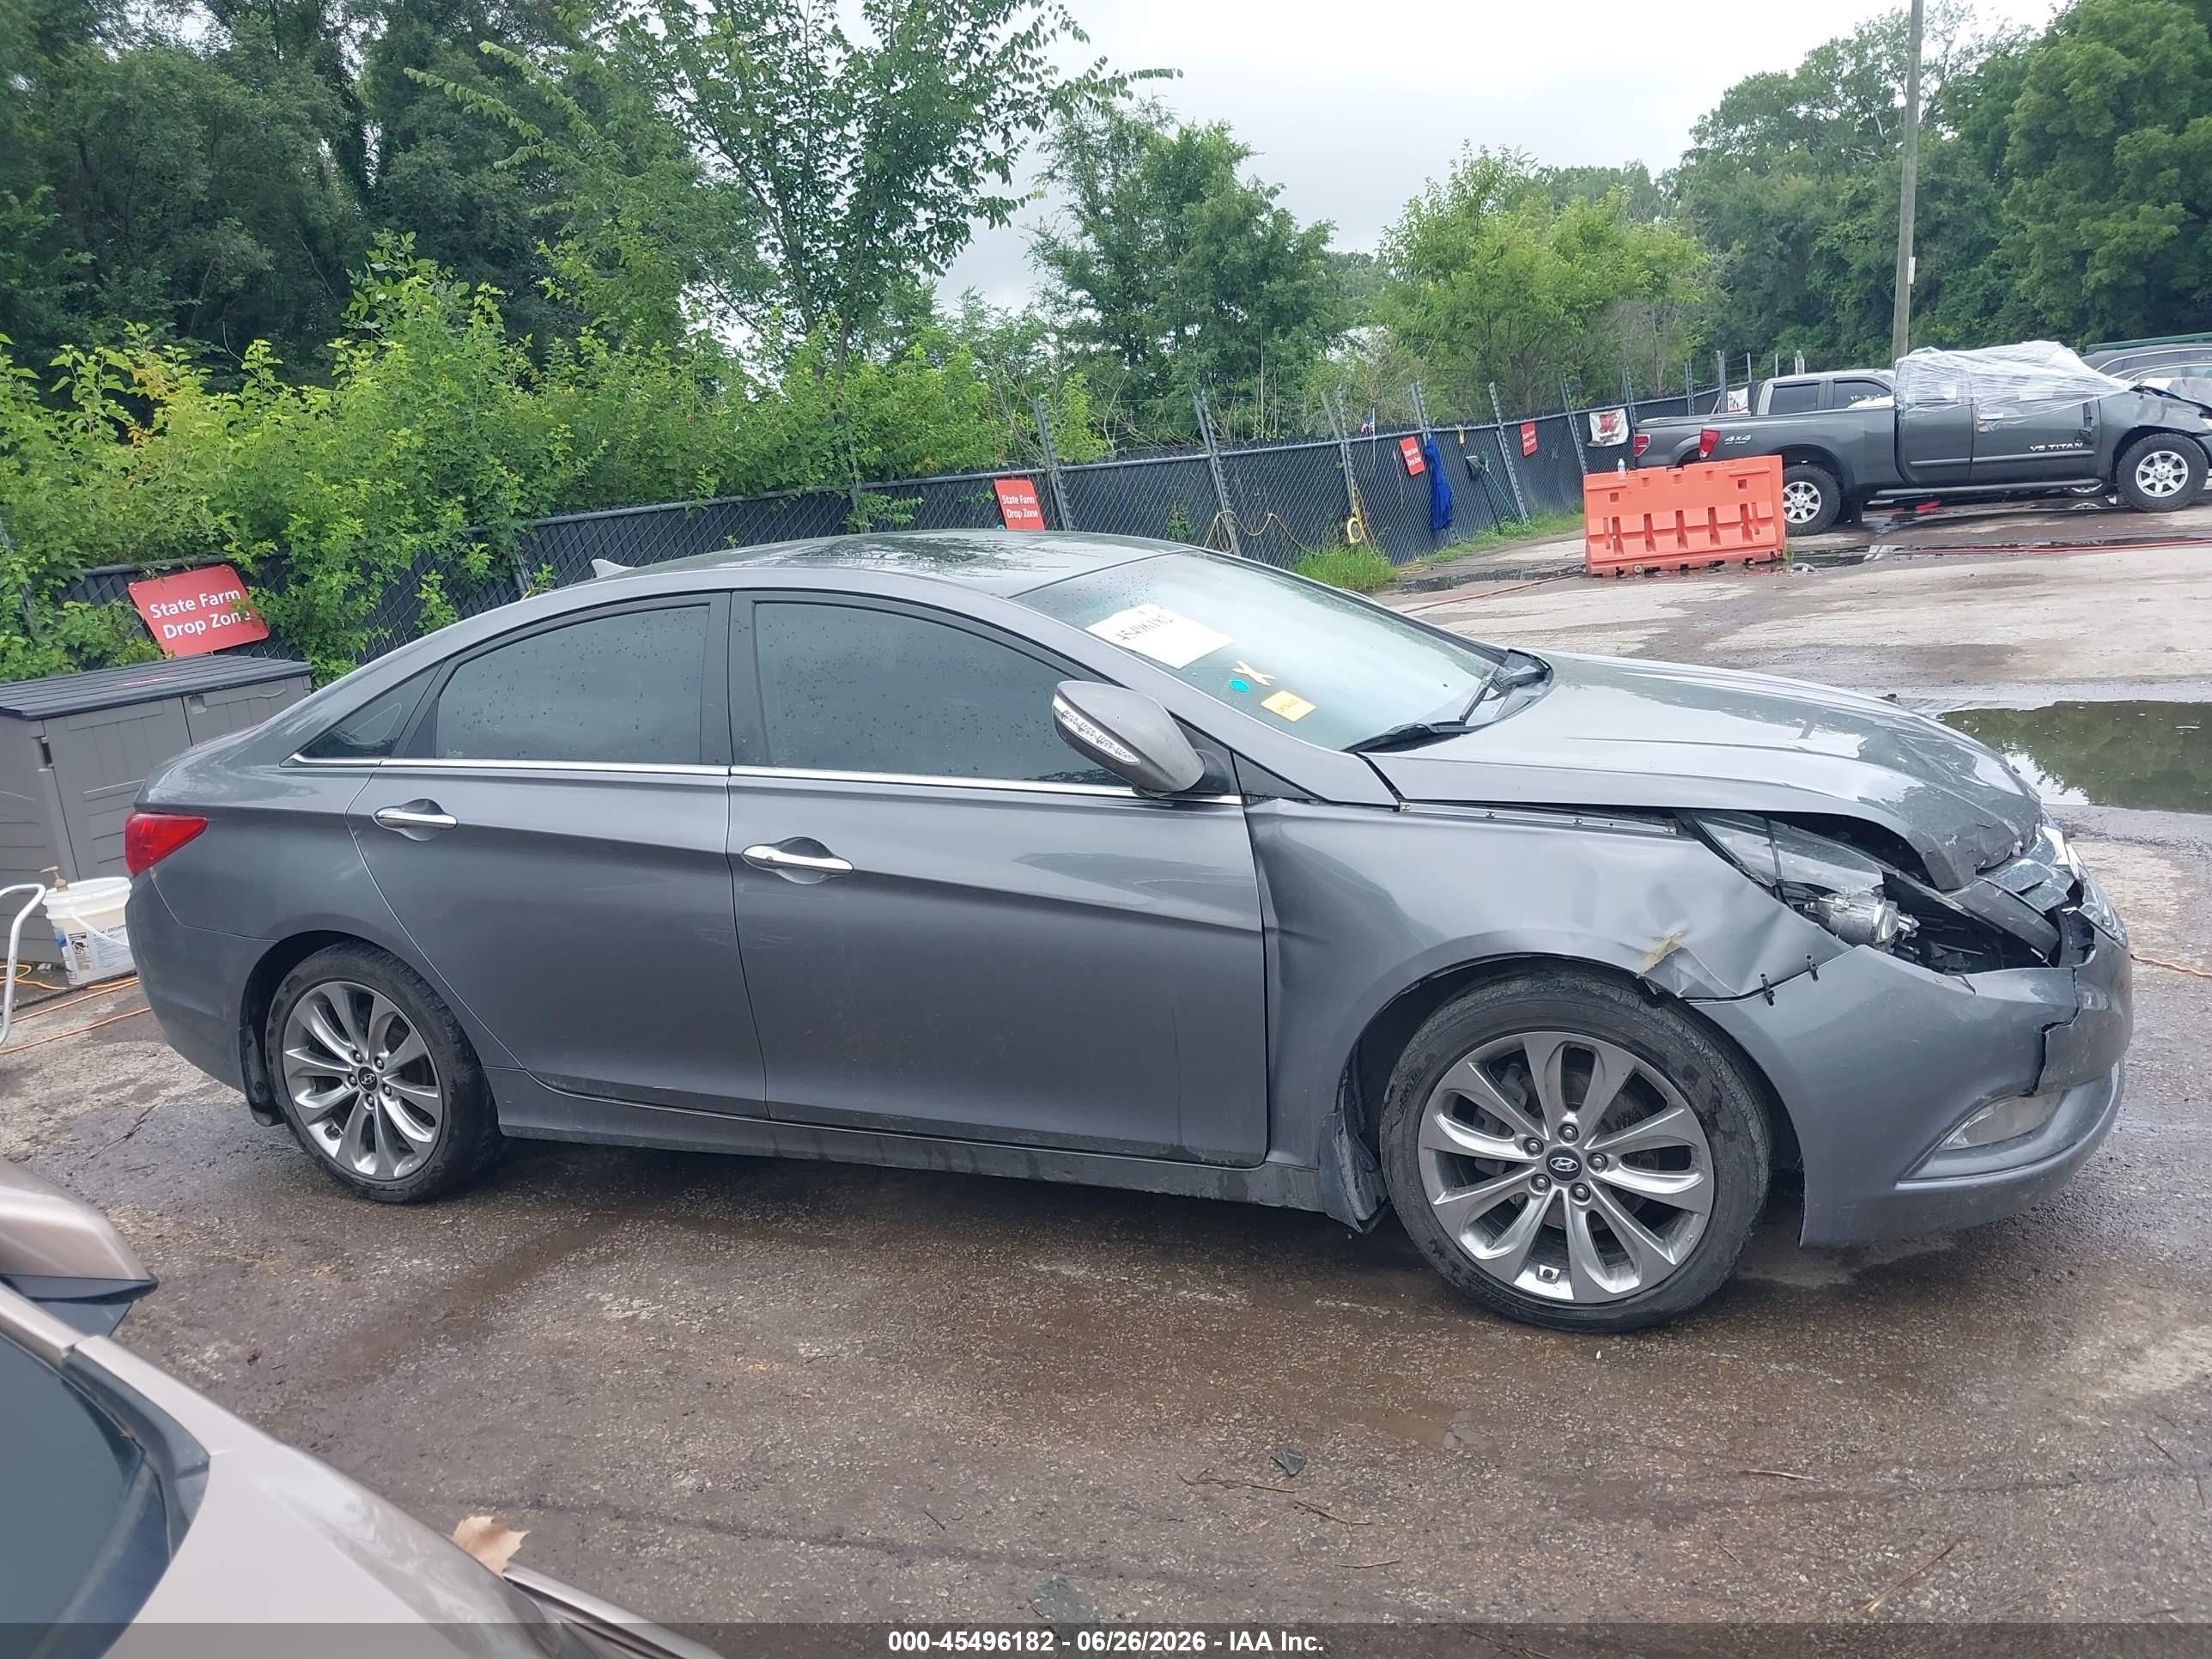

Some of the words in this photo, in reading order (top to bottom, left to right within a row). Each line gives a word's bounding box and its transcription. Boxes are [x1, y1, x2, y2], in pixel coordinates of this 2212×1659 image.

[2048, 441, 2083, 451] TITAN
[1001, 495, 1019, 505] State
[1019, 495, 1036, 504] Farm
[1006, 508, 1023, 520] Drop
[1022, 508, 1039, 518] Zone
[149, 599, 197, 619] State
[198, 589, 241, 608] Farm
[162, 618, 207, 640] Drop
